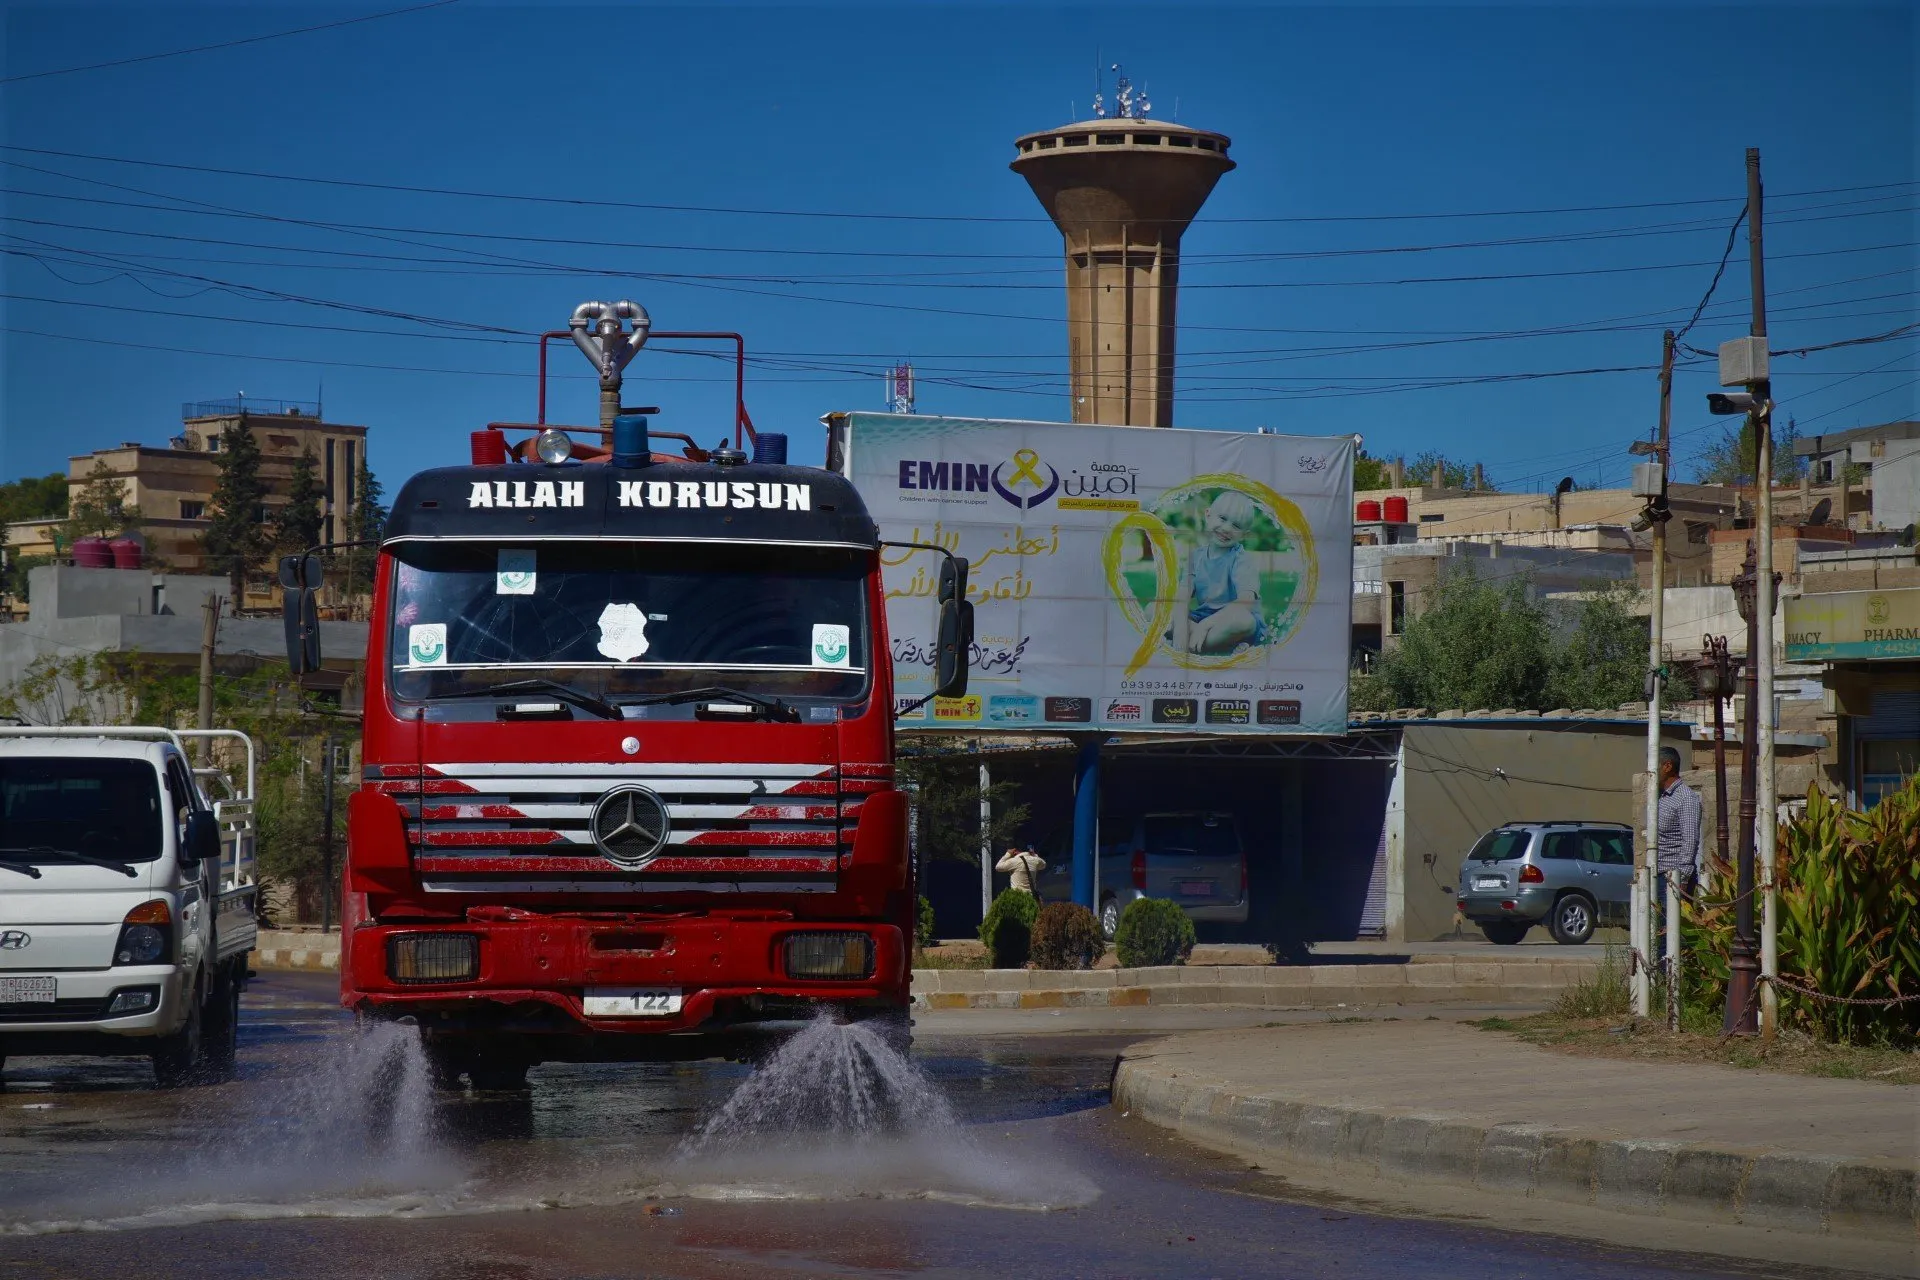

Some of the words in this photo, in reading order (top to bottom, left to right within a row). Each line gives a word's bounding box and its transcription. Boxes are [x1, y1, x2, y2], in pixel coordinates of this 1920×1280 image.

[1091, 461, 1126, 475] جمعية
[898, 460, 989, 493] EMIN
[467, 481, 584, 508] ALLAH
[618, 481, 811, 511] KORUSUN
[1120, 681, 1202, 690] 0939344877
[1214, 682, 1238, 690] الساحة
[1239, 682, 1253, 692] دوار
[1259, 682, 1295, 692] الكورنيش
[16, 979, 54, 989] 462623
[630, 991, 670, 1010] 122
